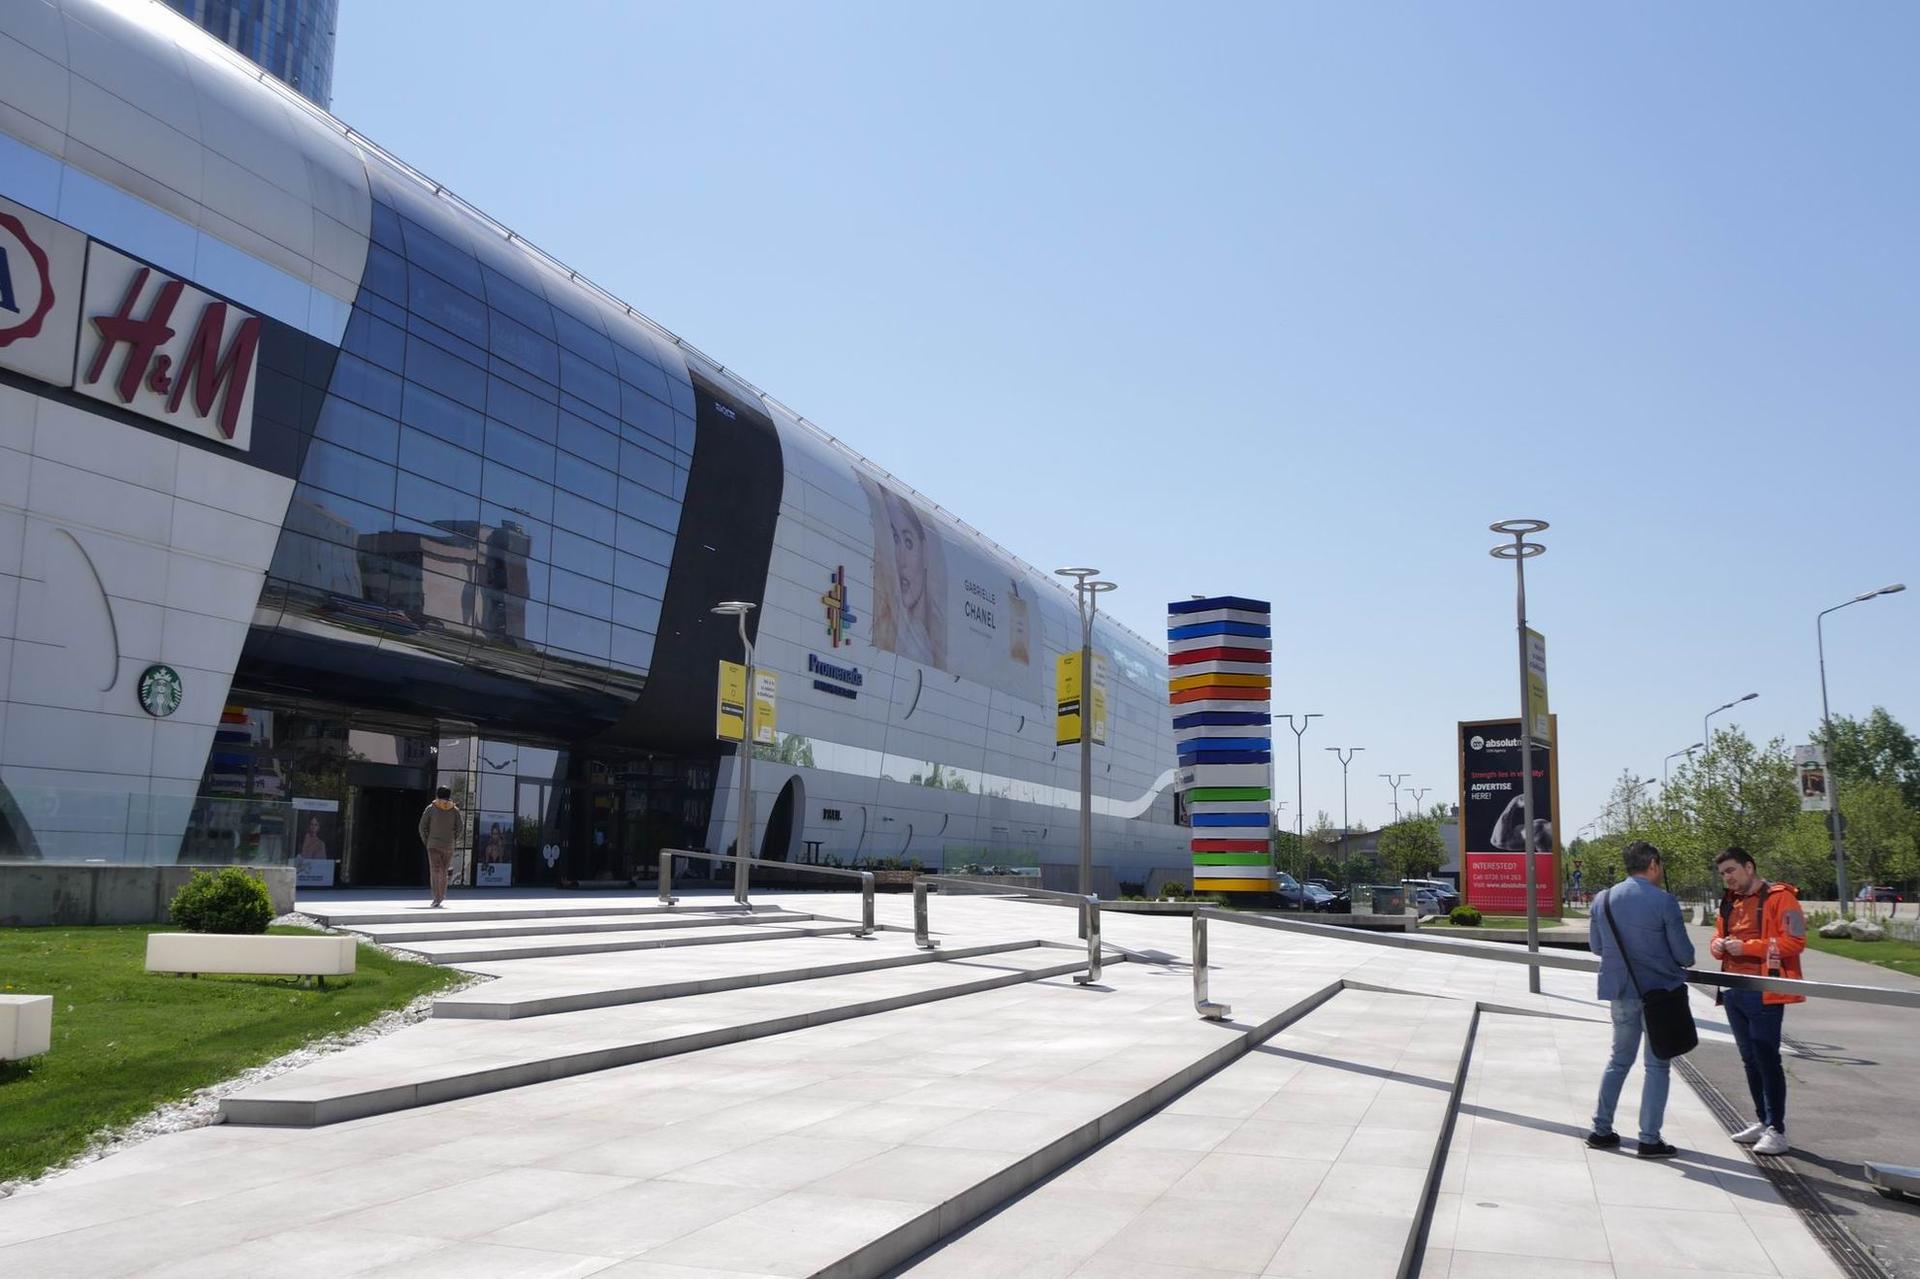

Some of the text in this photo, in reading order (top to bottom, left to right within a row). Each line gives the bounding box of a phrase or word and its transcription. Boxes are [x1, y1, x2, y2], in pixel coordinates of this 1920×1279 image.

[85, 267, 261, 440] H&M
[964, 579, 996, 606] GABRIELLE
[964, 601, 996, 630] CHANEL
[808, 653, 863, 687] Promenada
[1471, 782, 1512, 791] ADVERTISE
[1471, 792, 1492, 800] HERE!
[1472, 862, 1517, 870] INTERESTED?
